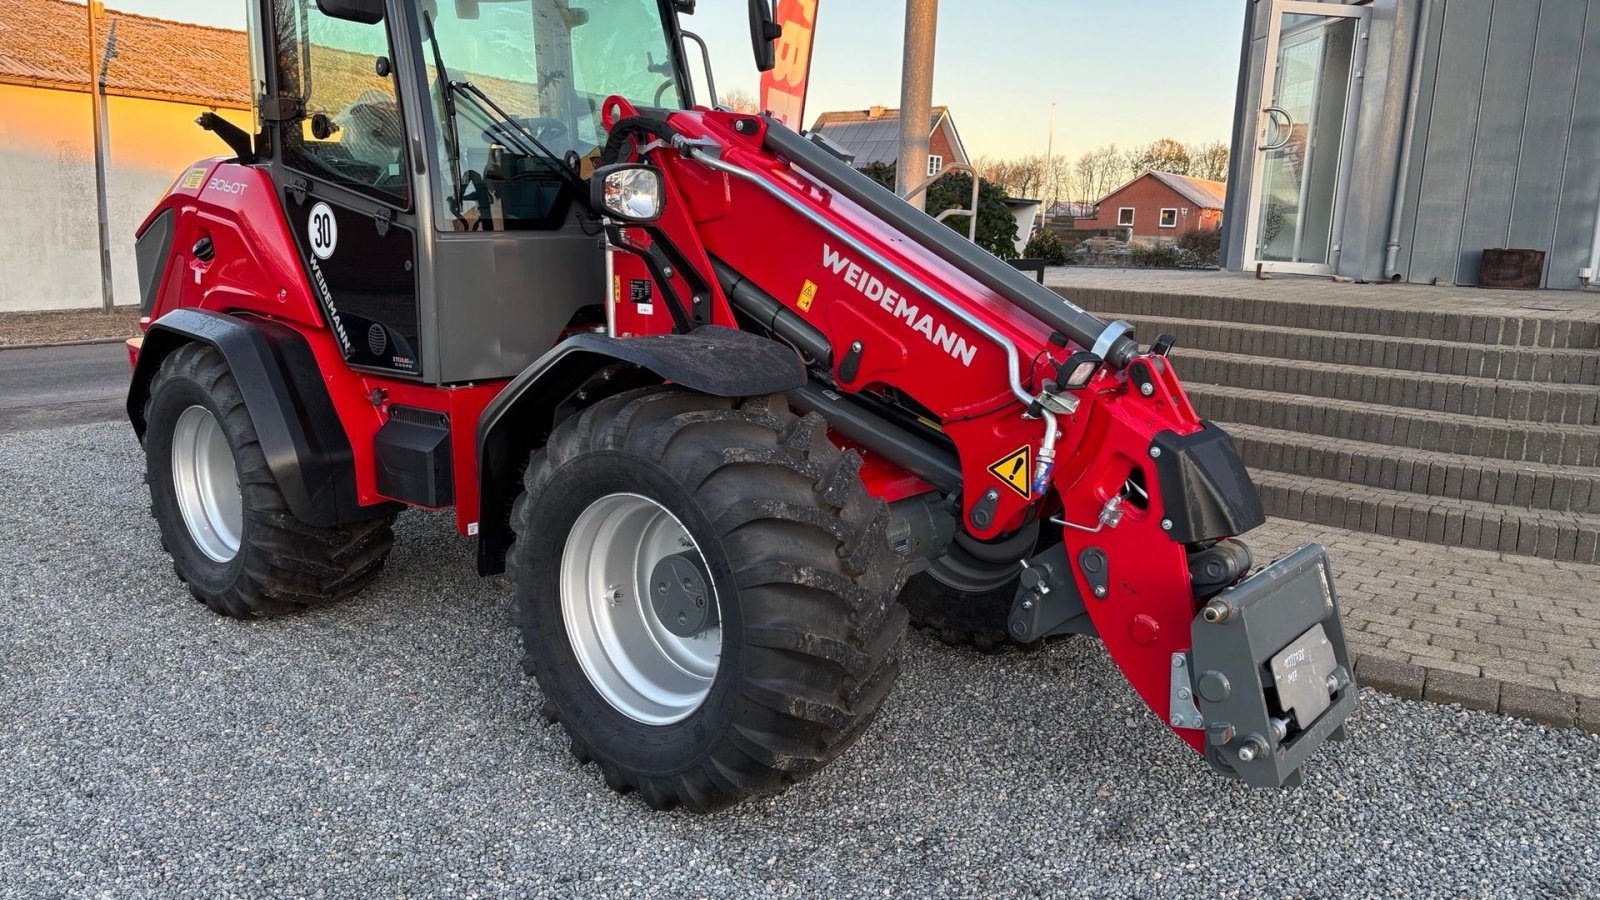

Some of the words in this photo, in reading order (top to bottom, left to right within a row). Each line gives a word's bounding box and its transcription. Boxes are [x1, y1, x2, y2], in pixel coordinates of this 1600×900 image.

[313, 213, 331, 249] 30
[309, 252, 352, 353] WEIDEMANN
[823, 243, 977, 367] WEIDEMANN
